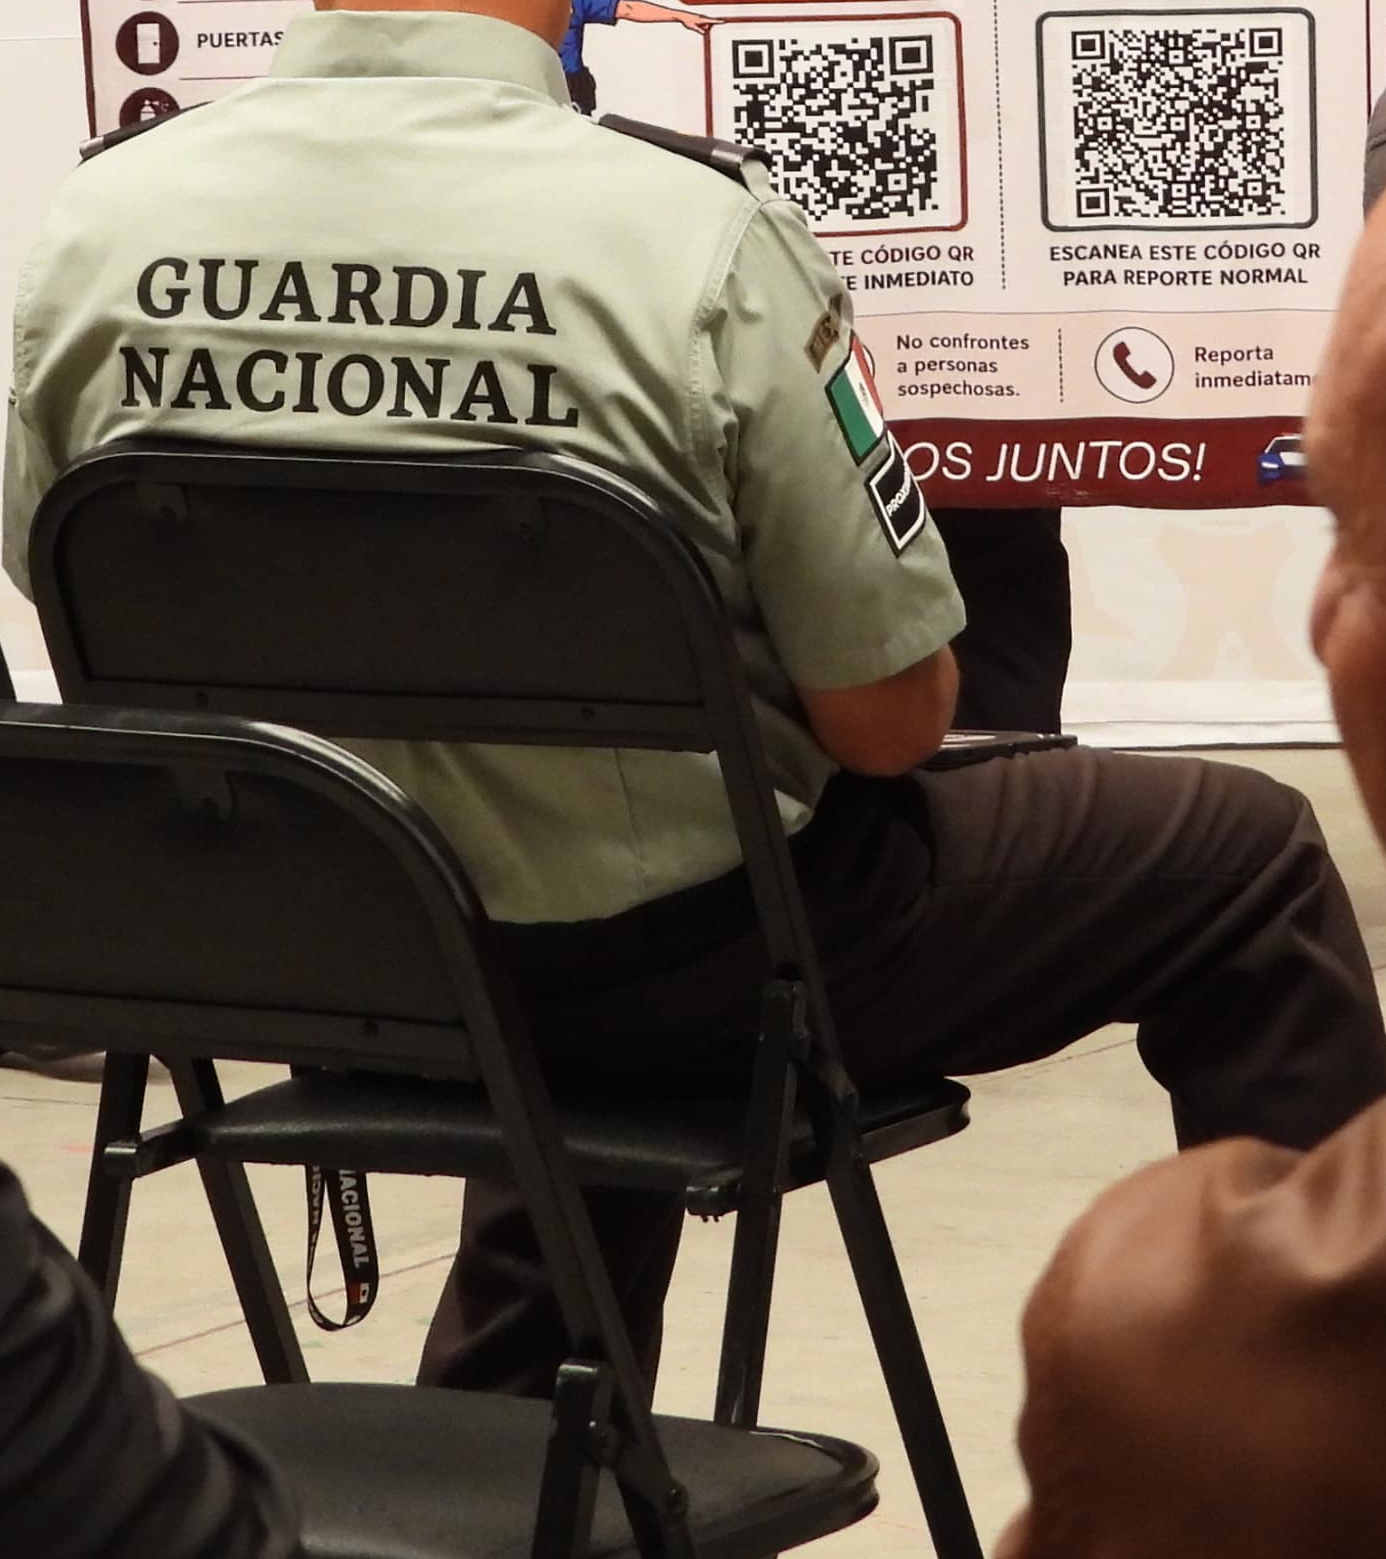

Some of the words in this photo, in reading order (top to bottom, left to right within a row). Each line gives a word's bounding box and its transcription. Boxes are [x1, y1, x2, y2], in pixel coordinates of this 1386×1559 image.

[828, 249, 854, 267] TE
[860, 244, 942, 265] CÓDIGO
[947, 245, 974, 262] QR
[1049, 243, 1144, 263] ESCANEA
[1149, 243, 1197, 262] ESTE
[1205, 240, 1286, 261] CÓDIGO
[1291, 242, 1322, 260] QR
[864, 270, 974, 290] INMEDIATO
[1063, 268, 1117, 287] PARA
[1123, 267, 1213, 287] REPORTE
[1219, 267, 1309, 286] NORMAL
[135, 256, 558, 336] GUARDIA
[896, 334, 923, 351] No
[929, 332, 1030, 351] confrontes
[1194, 345, 1274, 366] Reporta
[897, 360, 909, 373] a
[914, 358, 999, 378] personas
[118, 345, 580, 429] NACIONAL
[896, 379, 1021, 401] sospechosas.
[1194, 370, 1313, 389] inmediatam
[985, 440, 1207, 482] JUNTOS!
